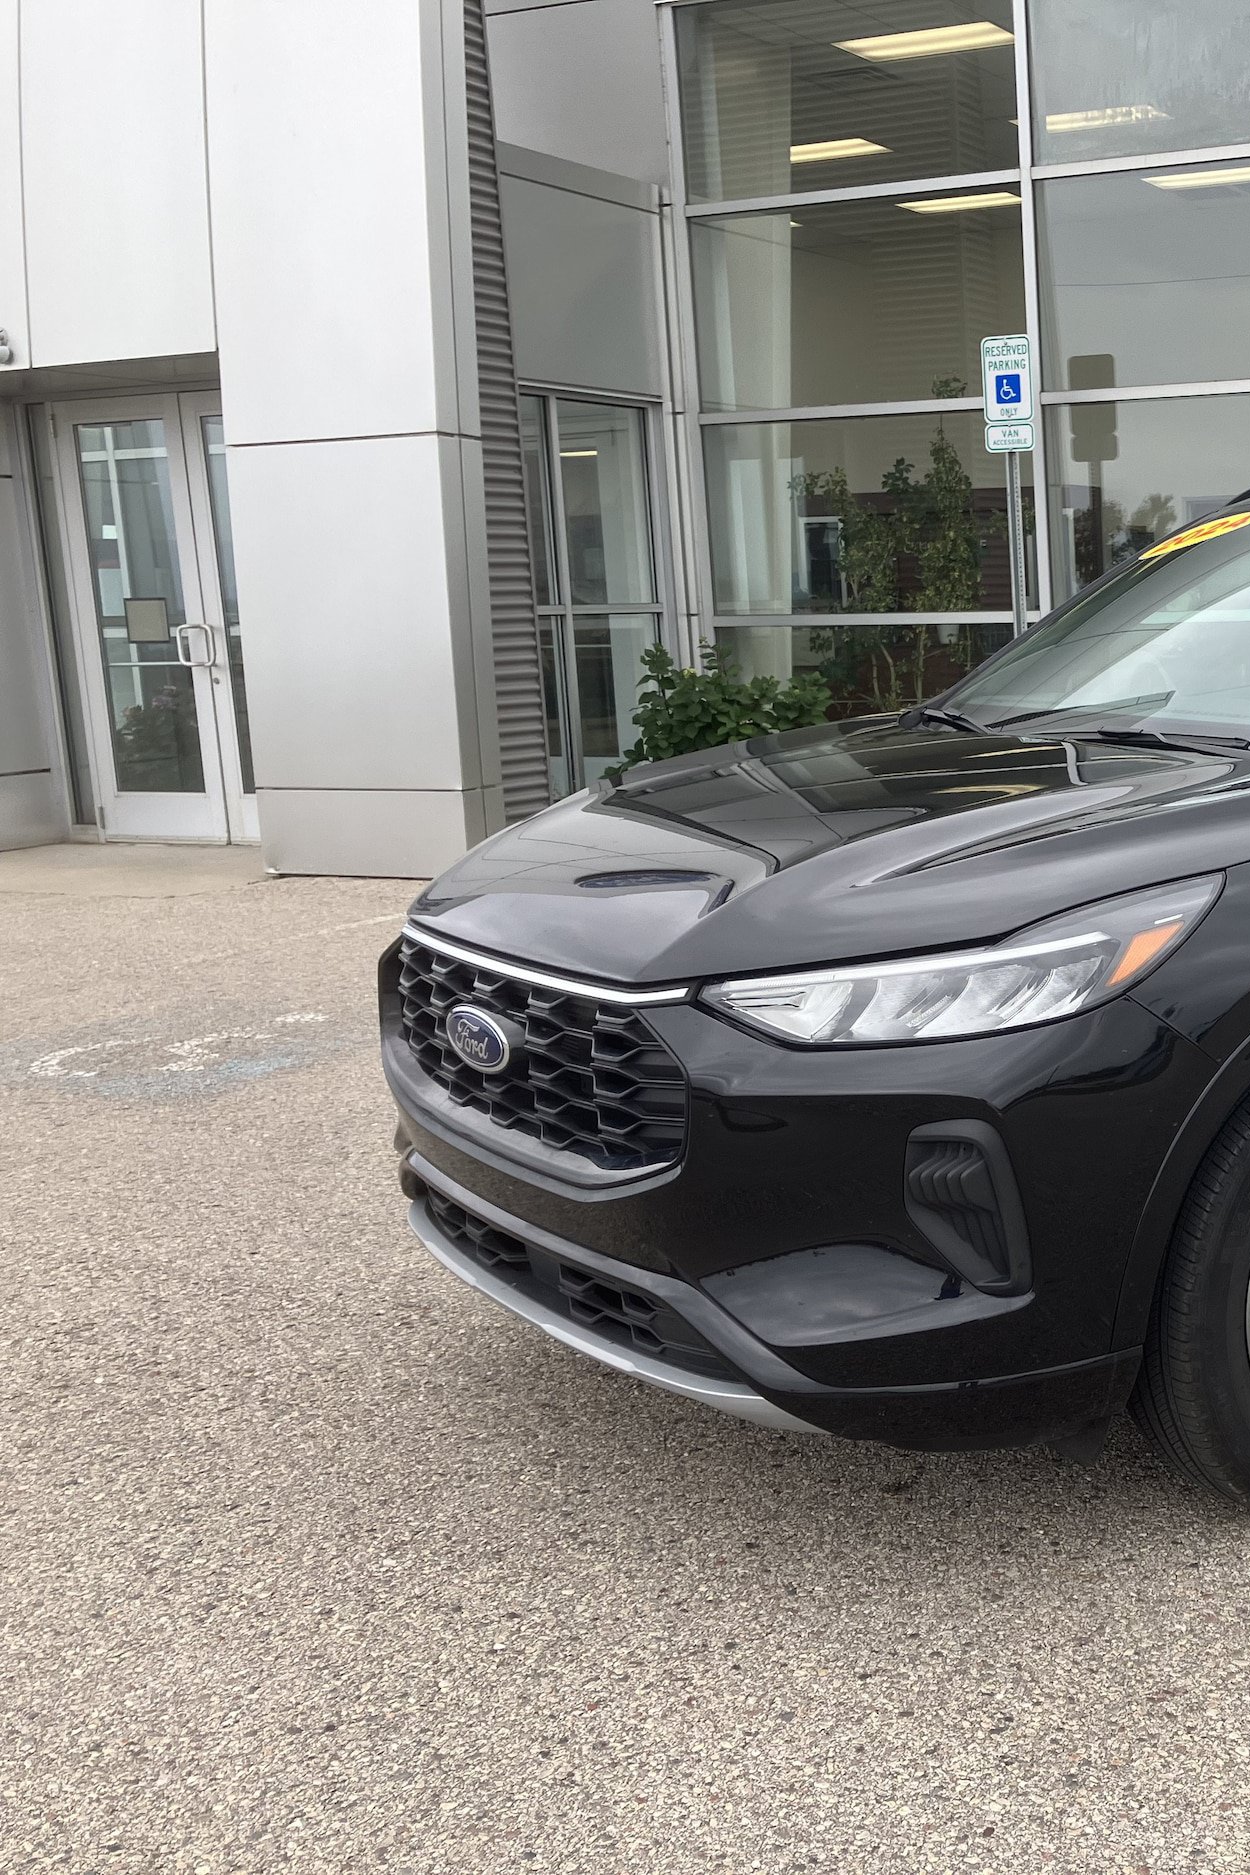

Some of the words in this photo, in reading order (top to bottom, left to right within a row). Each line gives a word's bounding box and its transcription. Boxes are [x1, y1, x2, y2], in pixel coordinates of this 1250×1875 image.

[985, 343, 1027, 357] RESERVED
[988, 359, 1026, 371] PARKING
[1000, 408, 1018, 416] ONLY
[1002, 429, 1019, 438] VAN
[992, 438, 1028, 446] ACCESSIBLE
[455, 1018, 489, 1060] Ford
